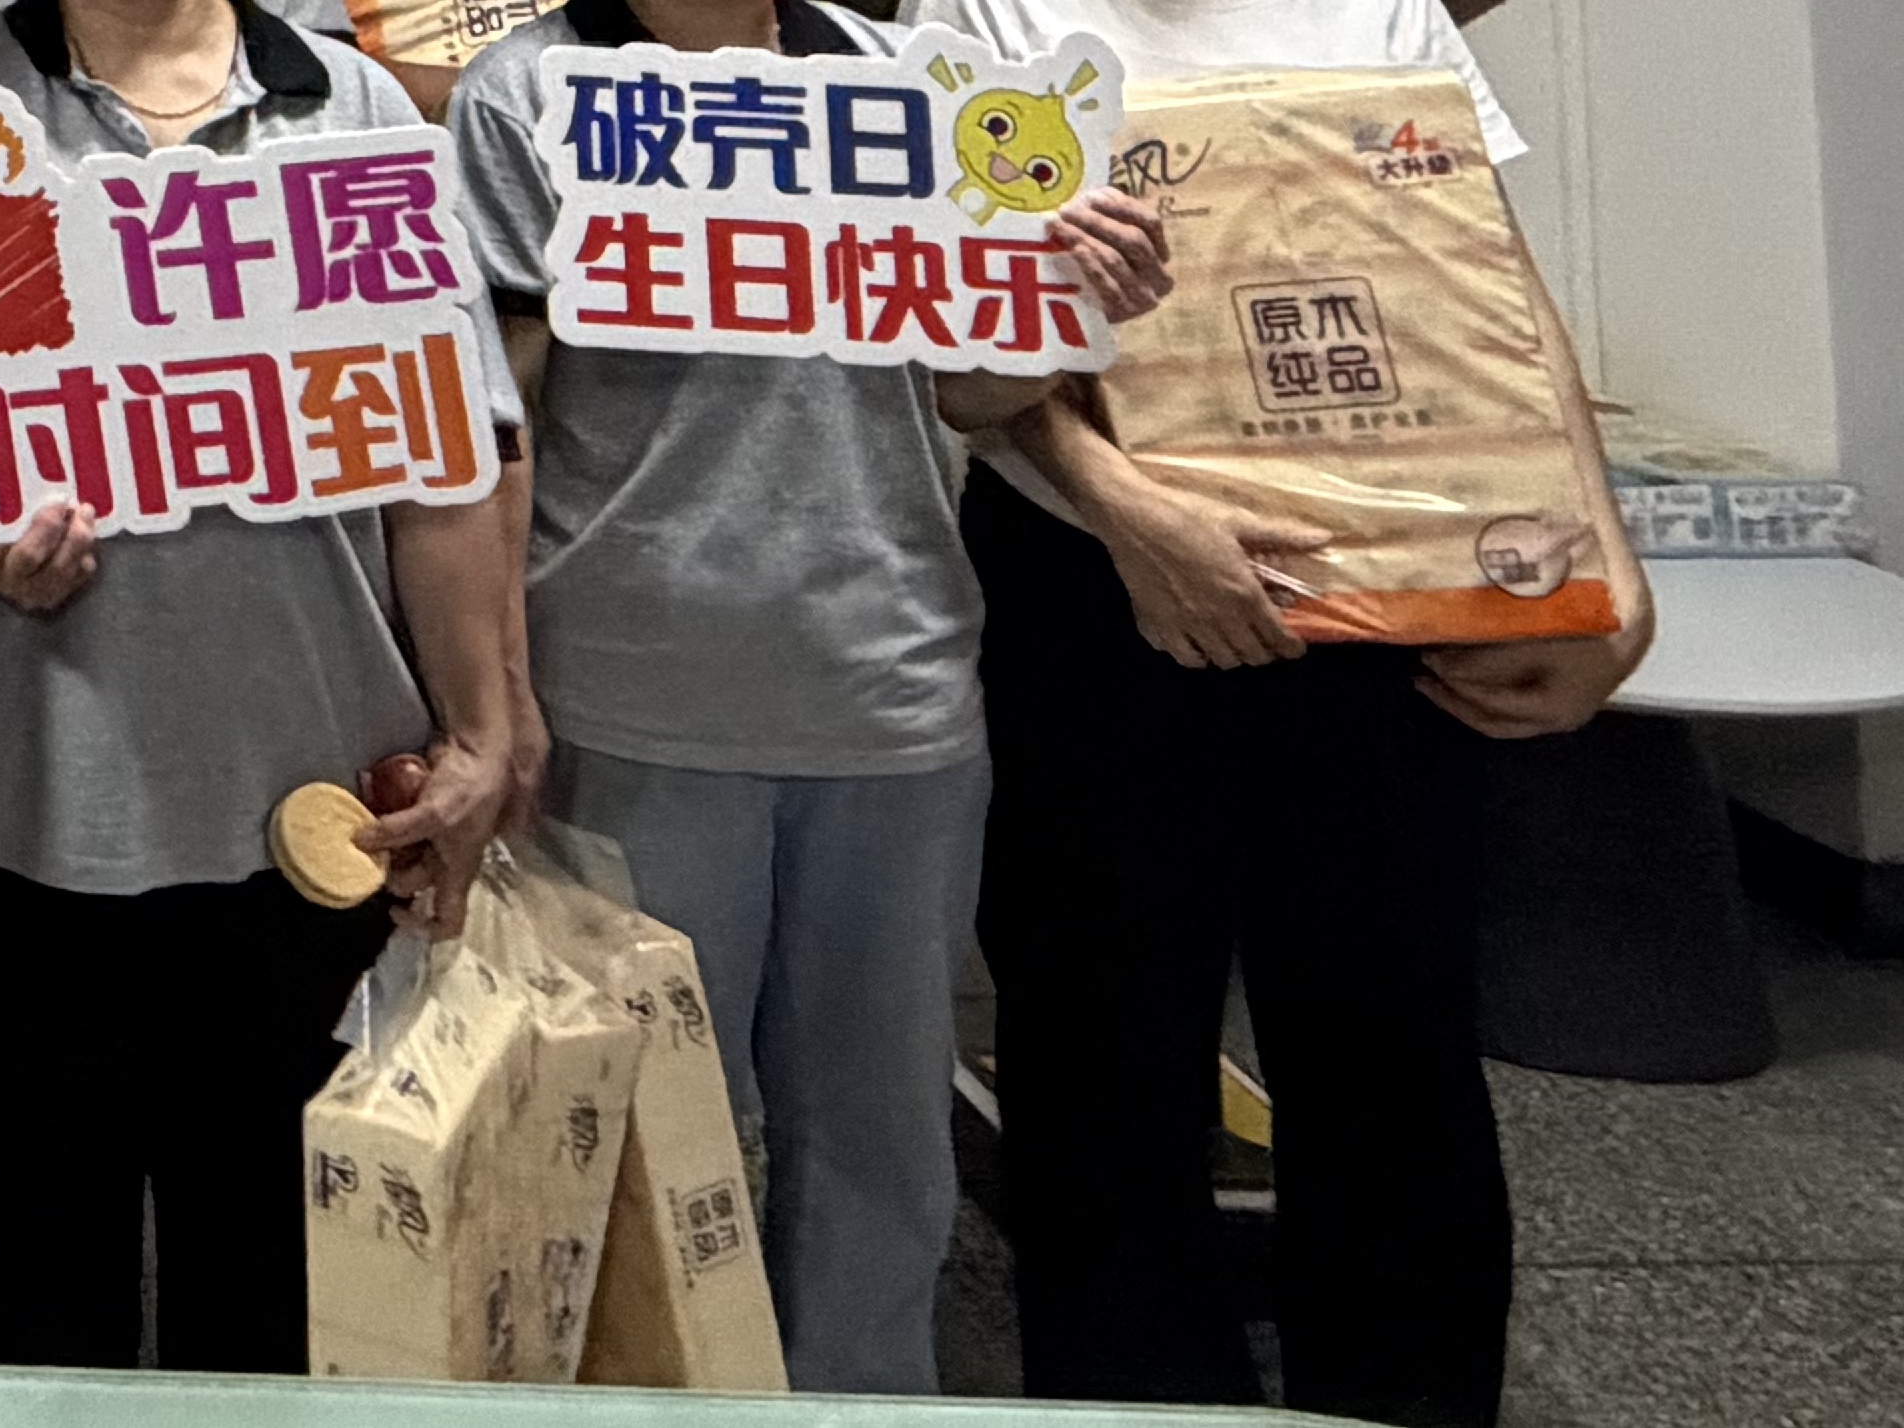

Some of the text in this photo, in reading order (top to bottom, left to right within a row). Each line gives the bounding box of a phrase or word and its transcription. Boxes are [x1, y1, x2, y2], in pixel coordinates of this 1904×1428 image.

[561, 70, 935, 200] 破壳日
[1391, 118, 1419, 157] 4
[101, 150, 461, 326] 许愿
[574, 213, 1090, 352] 生日快乐
[1250, 294, 1370, 345] 原木
[1265, 345, 1383, 399] 纯品
